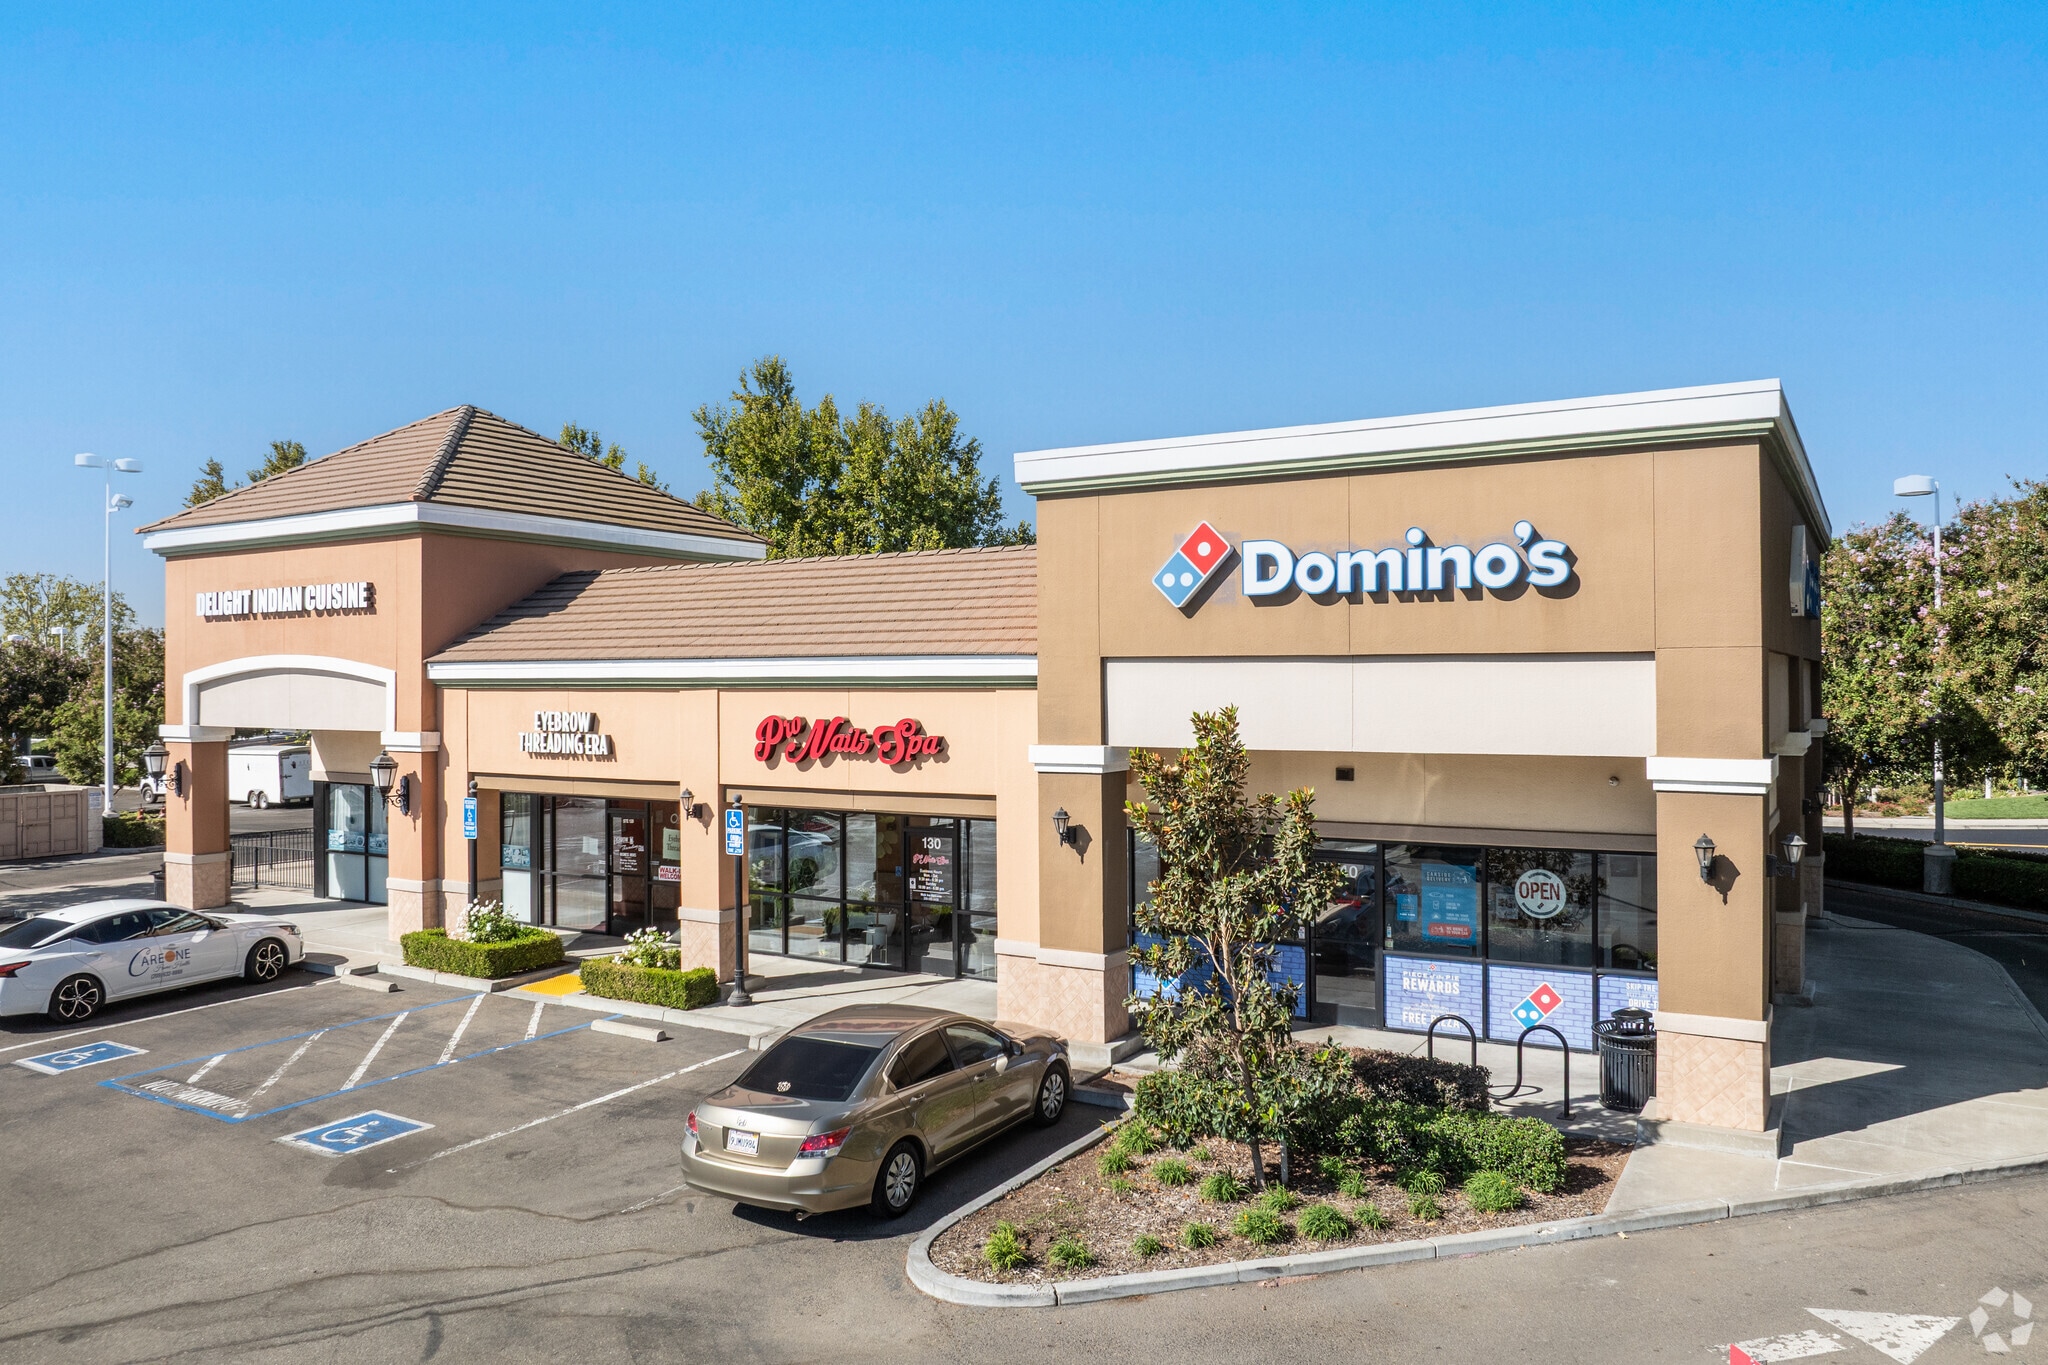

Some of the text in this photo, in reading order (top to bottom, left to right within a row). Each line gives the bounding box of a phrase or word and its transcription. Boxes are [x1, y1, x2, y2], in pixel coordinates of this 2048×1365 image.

[1242, 519, 1571, 597] Domino's
[196, 581, 369, 617] DELIGHT INDIAN CUISINE
[534, 710, 592, 733] EYEBROW
[518, 731, 609, 755] THREADING ERA
[754, 714, 938, 765] Pro Nails Spa
[922, 837, 942, 849] 130
[1519, 881, 1560, 901] OPEN
[1403, 971, 1427, 979] PIECE
[1403, 977, 1459, 994] REWARDS
[1626, 982, 1656, 992] SKIP THE
[1402, 1011, 1460, 1029] FREE PZZA
